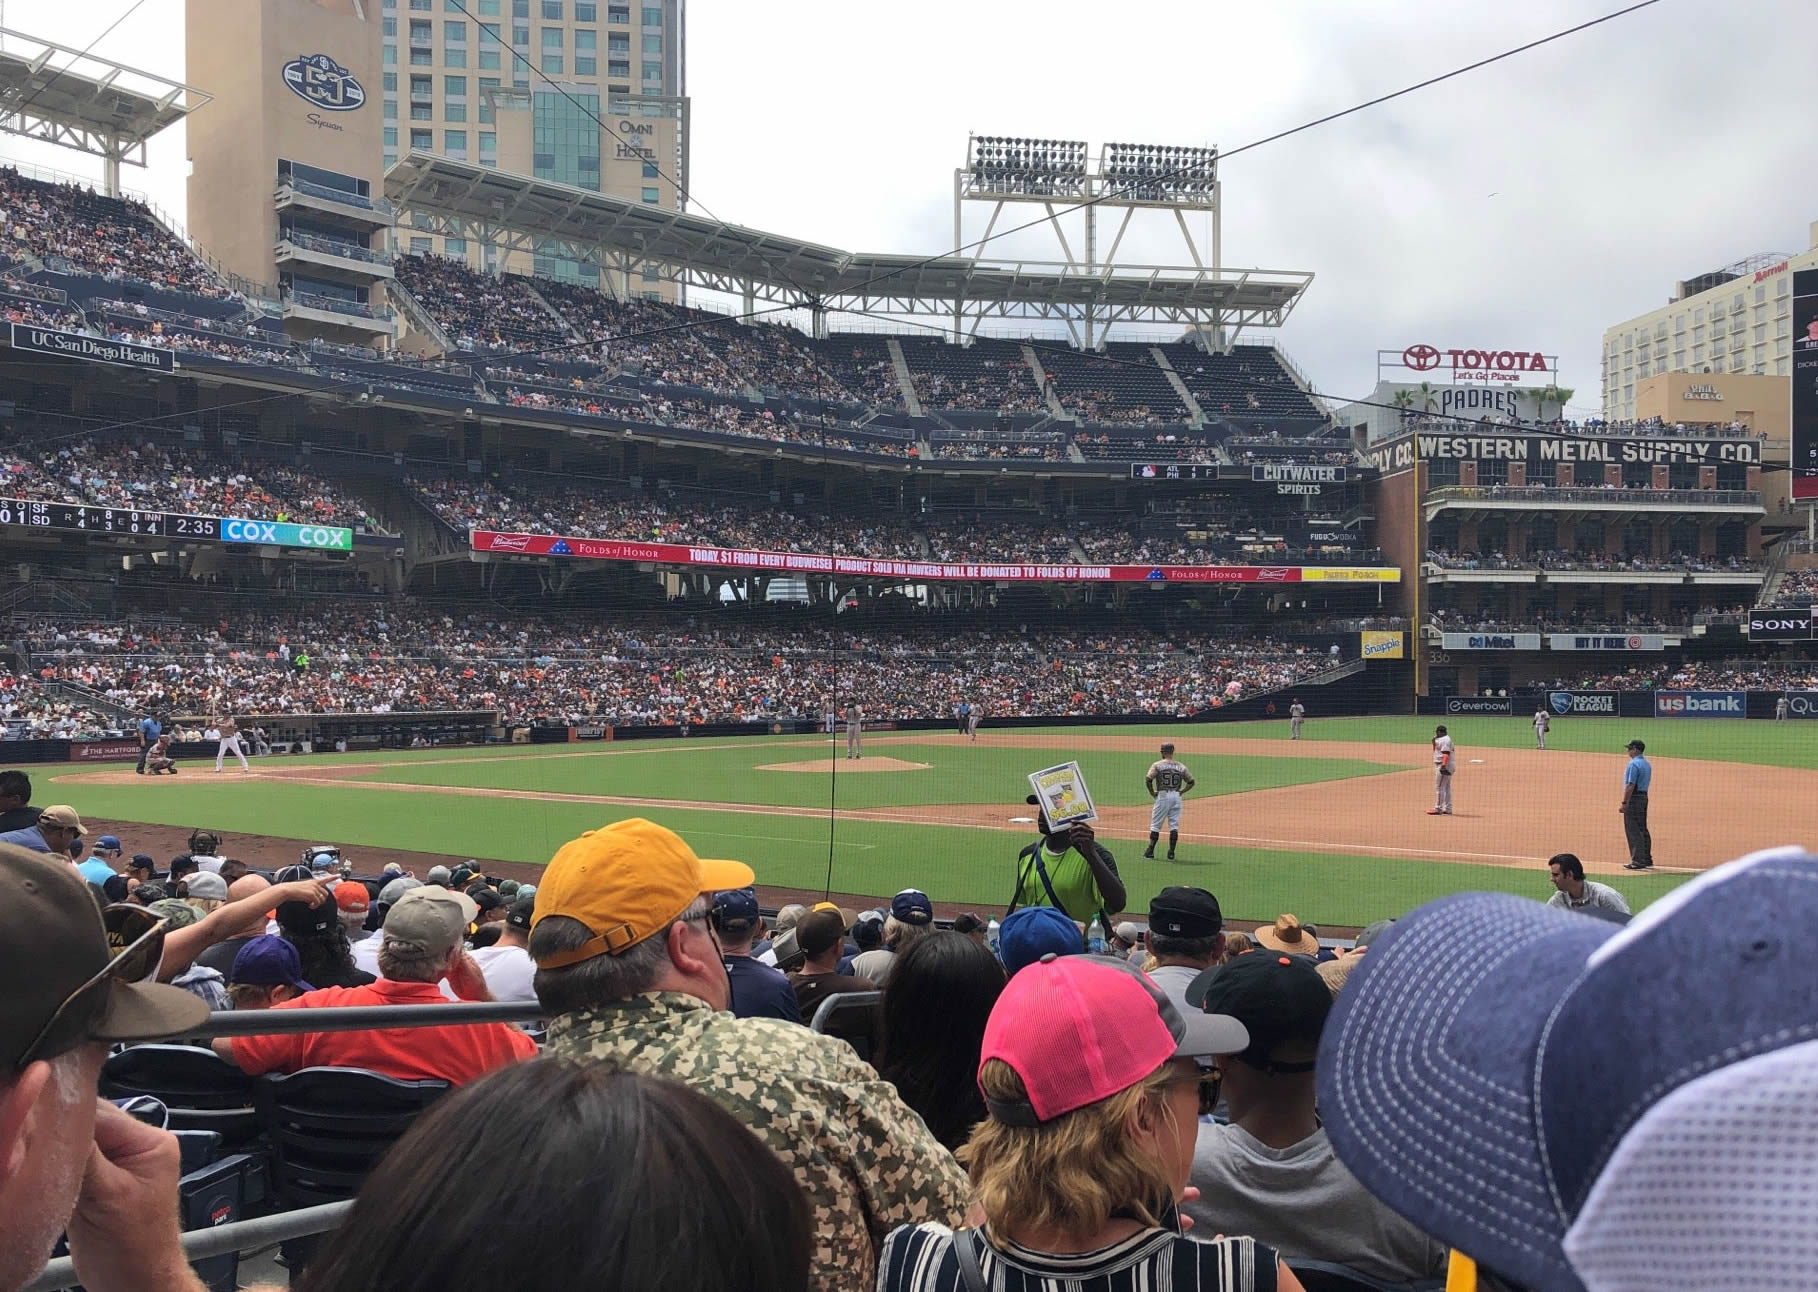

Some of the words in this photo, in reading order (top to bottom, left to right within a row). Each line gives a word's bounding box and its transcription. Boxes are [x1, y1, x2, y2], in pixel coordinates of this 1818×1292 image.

[307, 113, 344, 131] Sycuan
[31, 331, 53, 347] UC
[55, 335, 80, 352] San
[82, 340, 118, 360] Diego
[120, 345, 160, 365] Health
[1448, 350, 1547, 371] TOYOTA
[1454, 371, 1473, 380] Let's
[1475, 372, 1488, 380] Go
[1491, 372, 1520, 382] Places
[1442, 389, 1517, 417] PADRES
[1419, 437, 1527, 459] WESTERN
[1540, 440, 1616, 462] METAL
[1623, 442, 1710, 463] SUPPLY
[1720, 444, 1758, 463] CO.
[1206, 469, 1212, 477] F
[1264, 465, 1336, 481] CUTWATER
[1277, 484, 1321, 495] SPIRITS
[18, 511, 24, 524] 1
[32, 503, 48, 513] SF
[78, 508, 85, 517] 4
[105, 510, 112, 519] 8
[131, 513, 138, 522] 0
[144, 514, 161, 522] INN
[32, 515, 50, 525] SD
[78, 519, 85, 528] 4
[105, 521, 112, 530] 3
[131, 523, 138, 532] 0
[147, 523, 157, 534] 4
[177, 519, 214, 534] 2:35
[228, 522, 276, 542] COX
[300, 528, 344, 547] COX
[579, 543, 610, 555] FOLDS
[612, 547, 620, 556] of
[623, 546, 659, 558] HONOR
[734, 551, 757, 565] FROM
[760, 554, 785, 567] EVERY
[786, 556, 833, 569] BUDWEISER
[835, 559, 872, 572] PRODUCT
[873, 561, 892, 573] SOLD
[893, 563, 906, 574] VIA
[943, 566, 965, 577] WILL
[967, 567, 979, 577] BE
[980, 567, 1021, 577] DONATED
[1024, 567, 1035, 577] TO
[1037, 567, 1064, 578] FOLDS
[1066, 567, 1078, 578] OF
[1080, 567, 1111, 578] HONOR
[1172, 570, 1199, 579] FOLDS
[1210, 570, 1243, 579] HONOR
[1751, 619, 1810, 630] SONY
[1364, 638, 1400, 655] Snapple
[1484, 636, 1515, 649] Mitel
[1430, 651, 1450, 663] 336
[1462, 701, 1510, 710] everbowl
[1573, 695, 1613, 704] ROCKET
[1573, 703, 1613, 711] LEAGUE
[1162, 772, 1180, 786] 56
